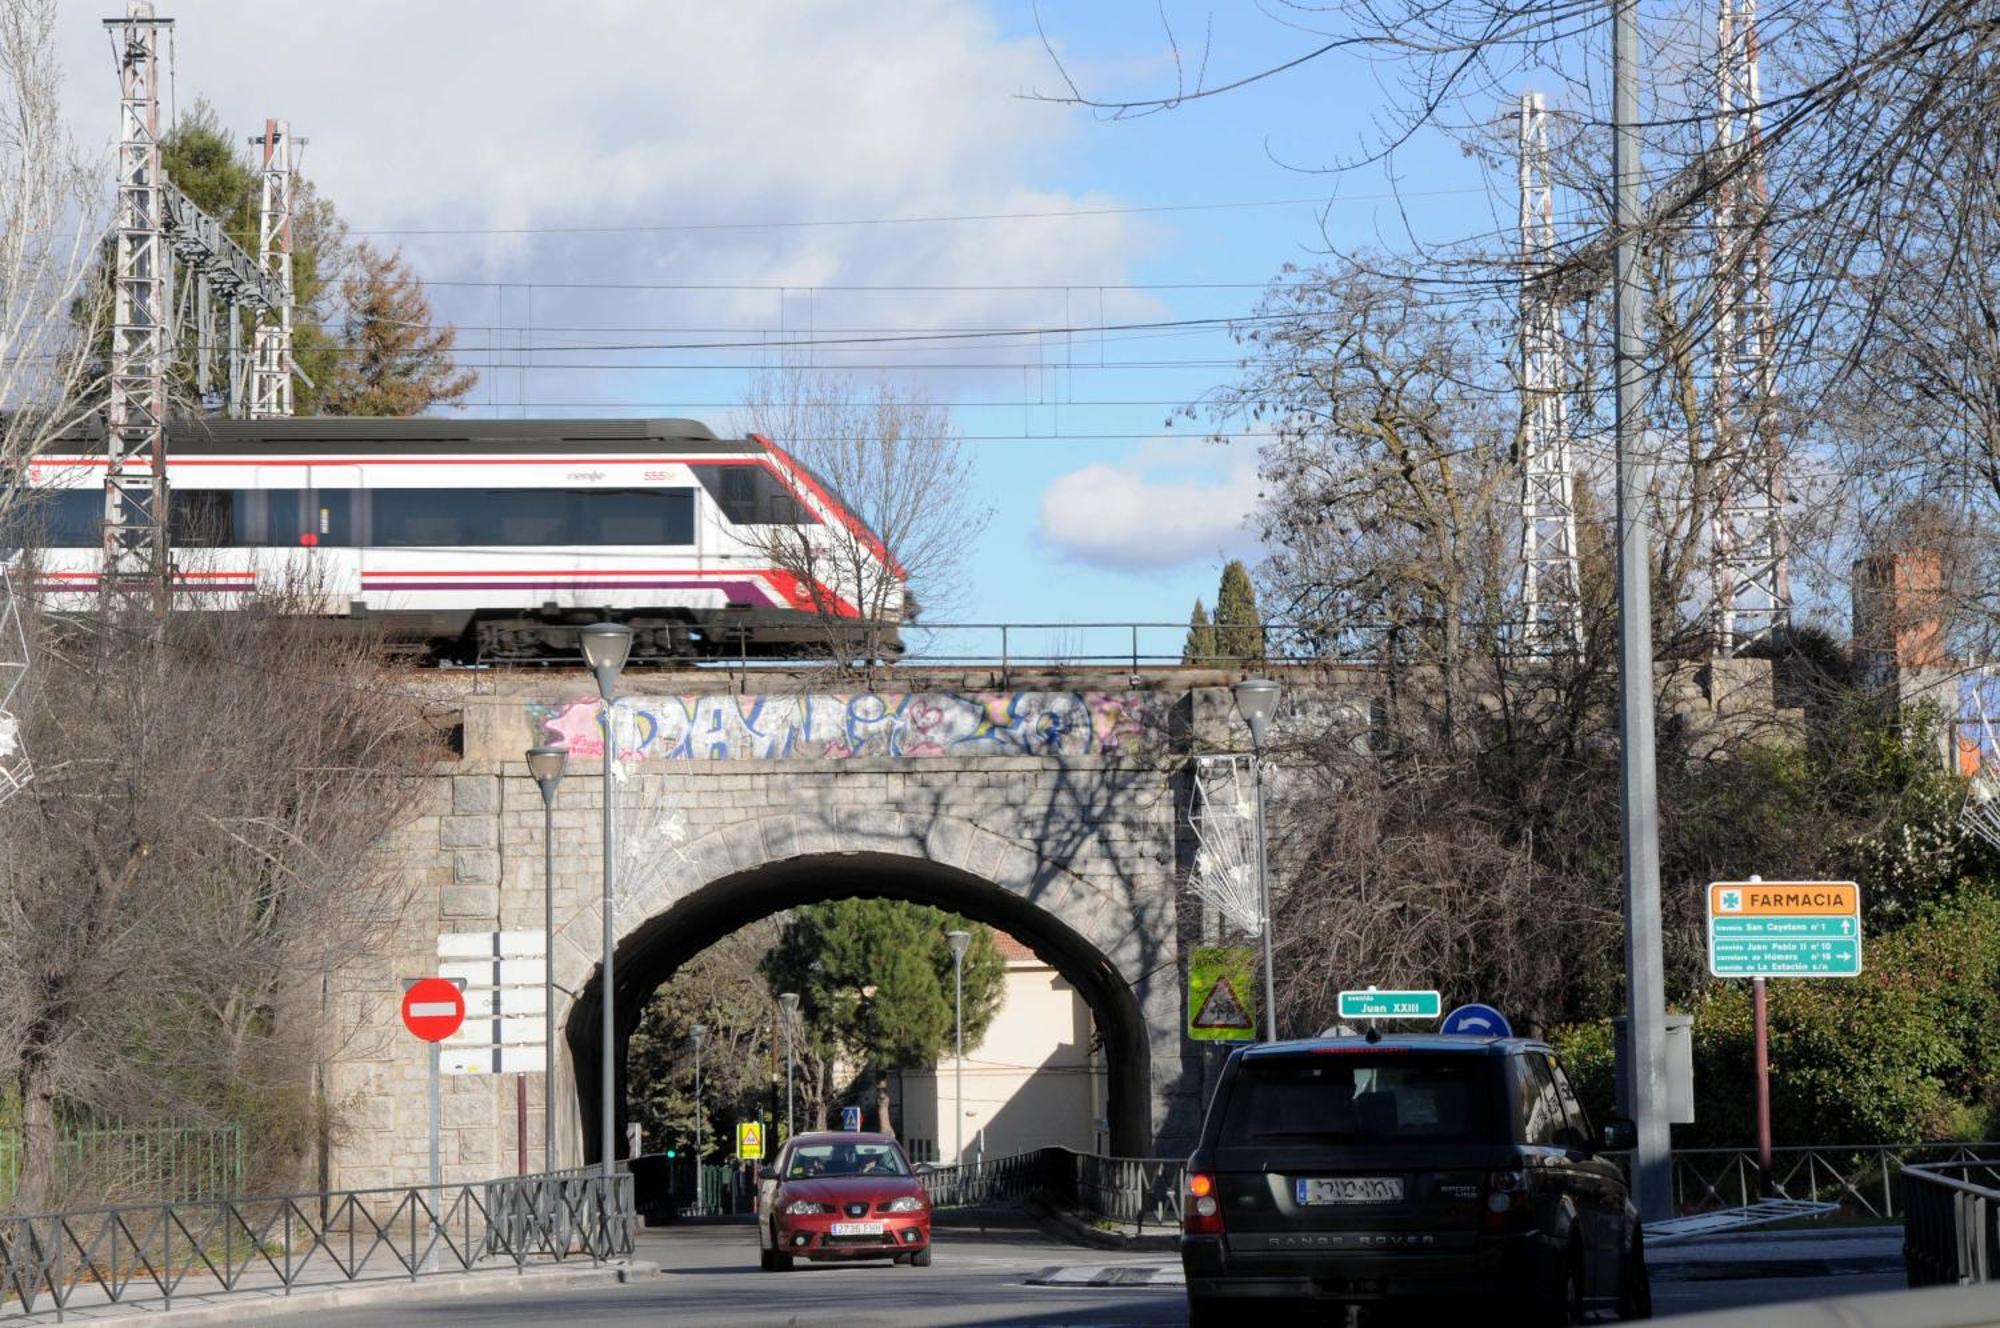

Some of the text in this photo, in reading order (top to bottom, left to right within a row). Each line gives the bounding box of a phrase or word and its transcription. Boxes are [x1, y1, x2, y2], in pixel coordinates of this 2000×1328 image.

[1750, 893, 1844, 907] FARMACIA
[1746, 923, 1763, 931] San
[1766, 922, 1807, 933] Cayetano
[1747, 942, 1768, 951] Juan
[1772, 942, 1797, 951] Pablo
[1799, 942, 1808, 951] II
[1821, 942, 1832, 951] 10
[1764, 951, 1798, 961] Húmera
[1757, 963, 1768, 971] La
[1771, 961, 1808, 970] Estación
[1360, 1003, 1419, 1013] Juan XXIII
[1268, 1235, 1434, 1246] RANGE ROVER
